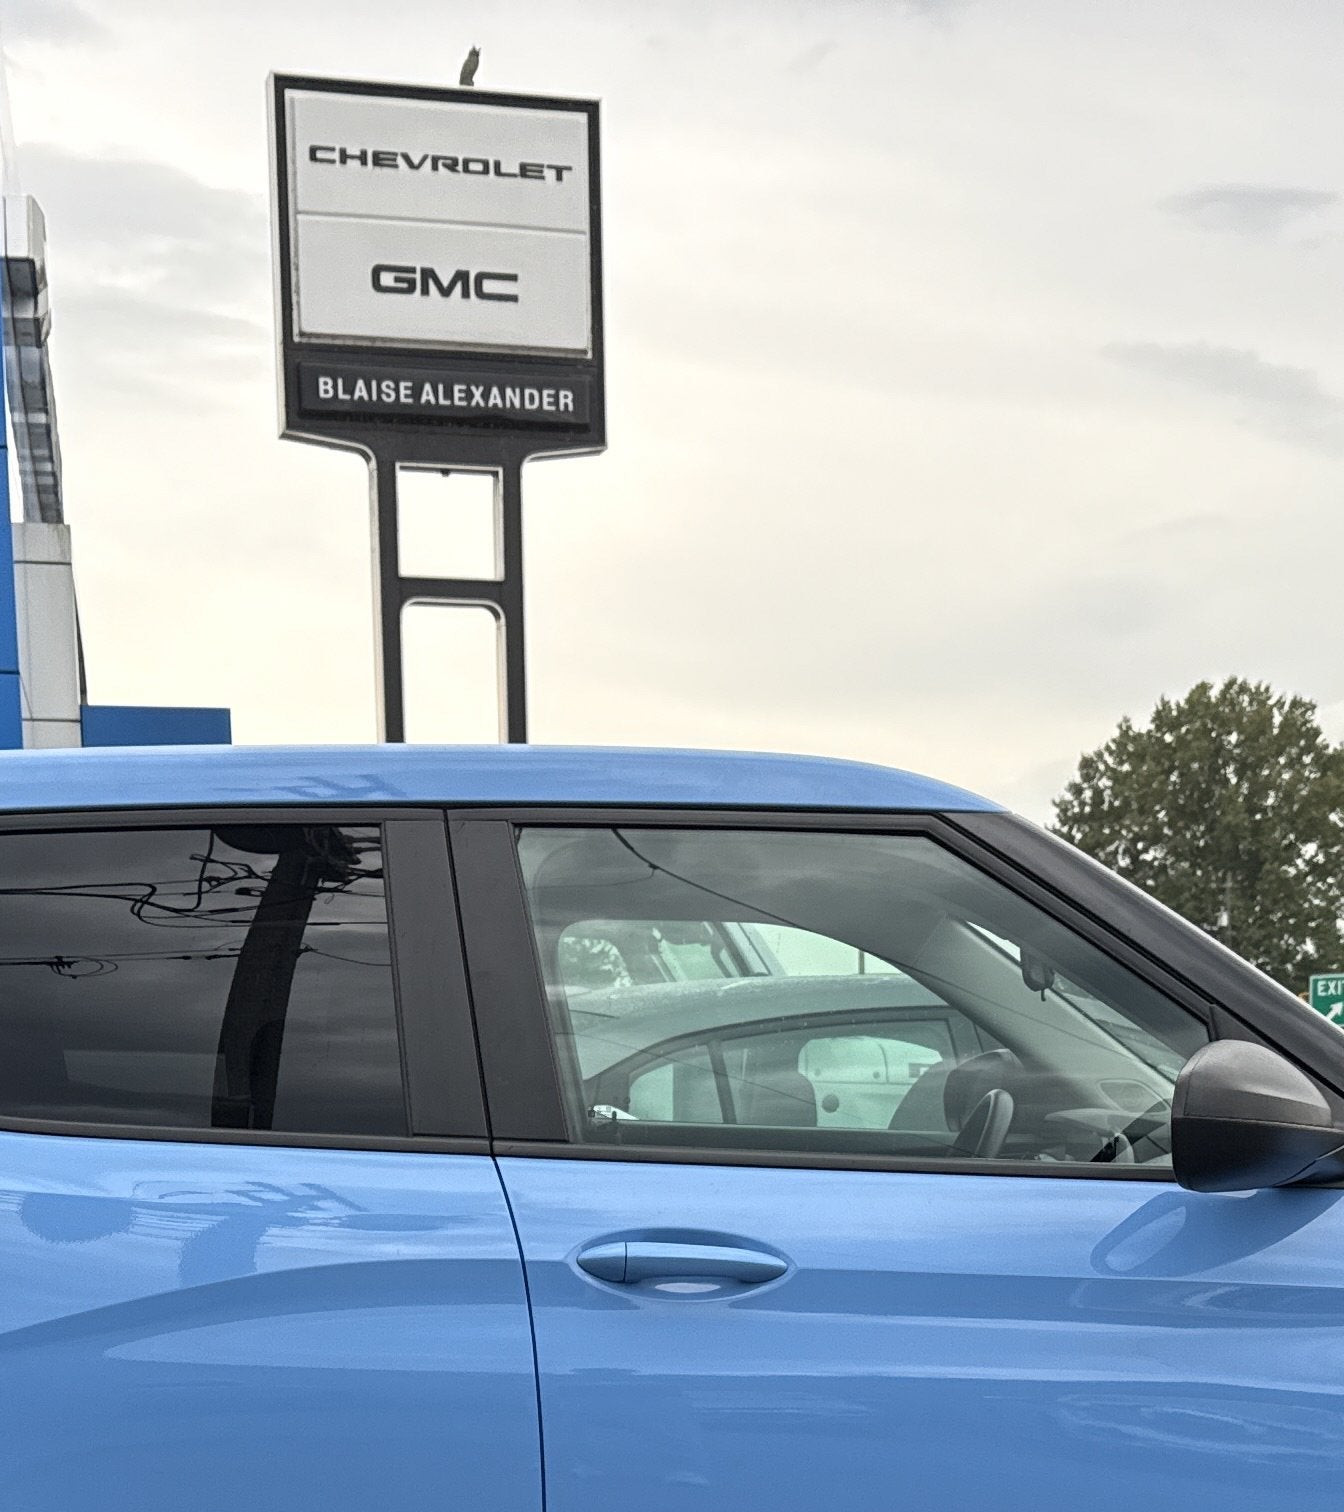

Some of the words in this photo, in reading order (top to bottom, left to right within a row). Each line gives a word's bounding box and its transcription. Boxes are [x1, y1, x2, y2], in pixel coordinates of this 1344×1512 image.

[309, 145, 572, 182] CHEVROLET
[371, 263, 519, 303] GMC
[318, 376, 413, 404] BLAISE
[420, 382, 575, 412] ALEXANDER
